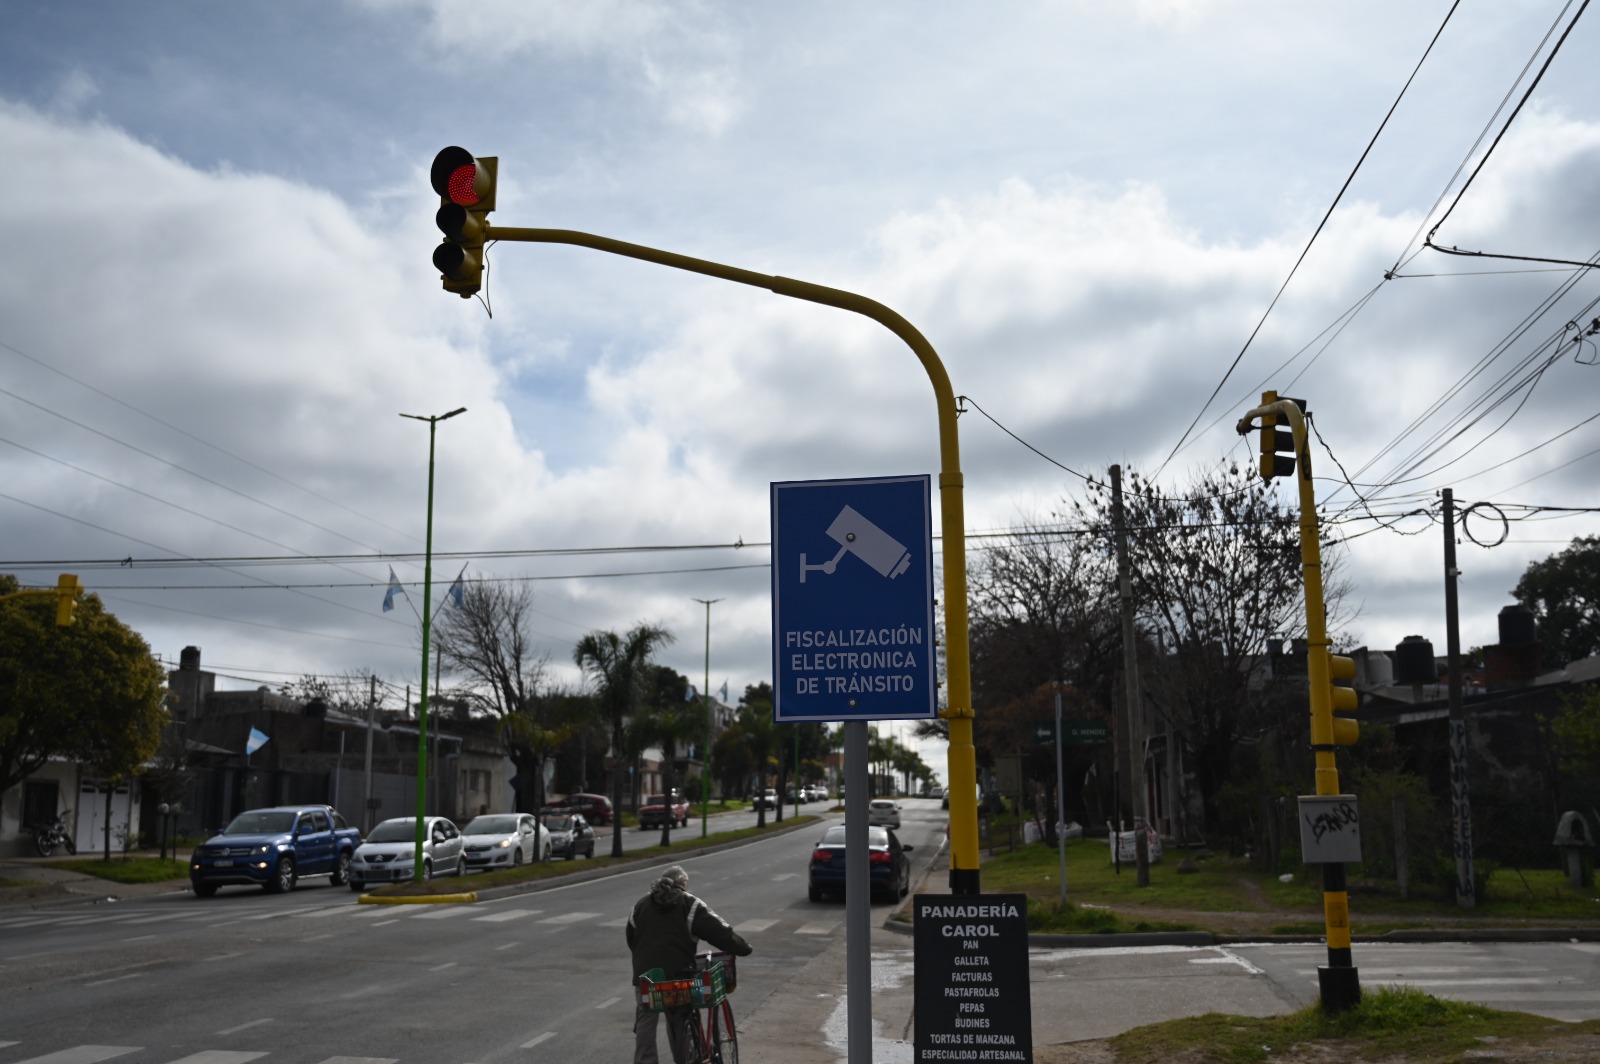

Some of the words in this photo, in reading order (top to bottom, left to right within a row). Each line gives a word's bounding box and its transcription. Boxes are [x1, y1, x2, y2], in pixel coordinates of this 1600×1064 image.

[786, 623, 922, 648] FISCALIZACIÓN
[791, 651, 917, 671] ELECTRONICA
[796, 677, 819, 695] DE
[825, 672, 914, 694] TRÁNSITO
[921, 902, 1019, 918] PANADERÍA
[941, 924, 1000, 937] CAROL
[963, 940, 979, 950] PAN
[954, 956, 990, 966] GALLETA
[951, 971, 993, 982] FACTURAS
[944, 987, 1000, 998] PASTAFROLAS
[959, 1002, 985, 1013] PEPAS
[954, 1017, 990, 1028] BUDINES
[930, 1033, 961, 1044] TORTAS
[963, 1034, 974, 1044] DE
[975, 1034, 1016, 1045] MANZANA
[921, 1049, 978, 1060] ESPECIALIDAD
[979, 1050, 1026, 1061] ARTESANAL
